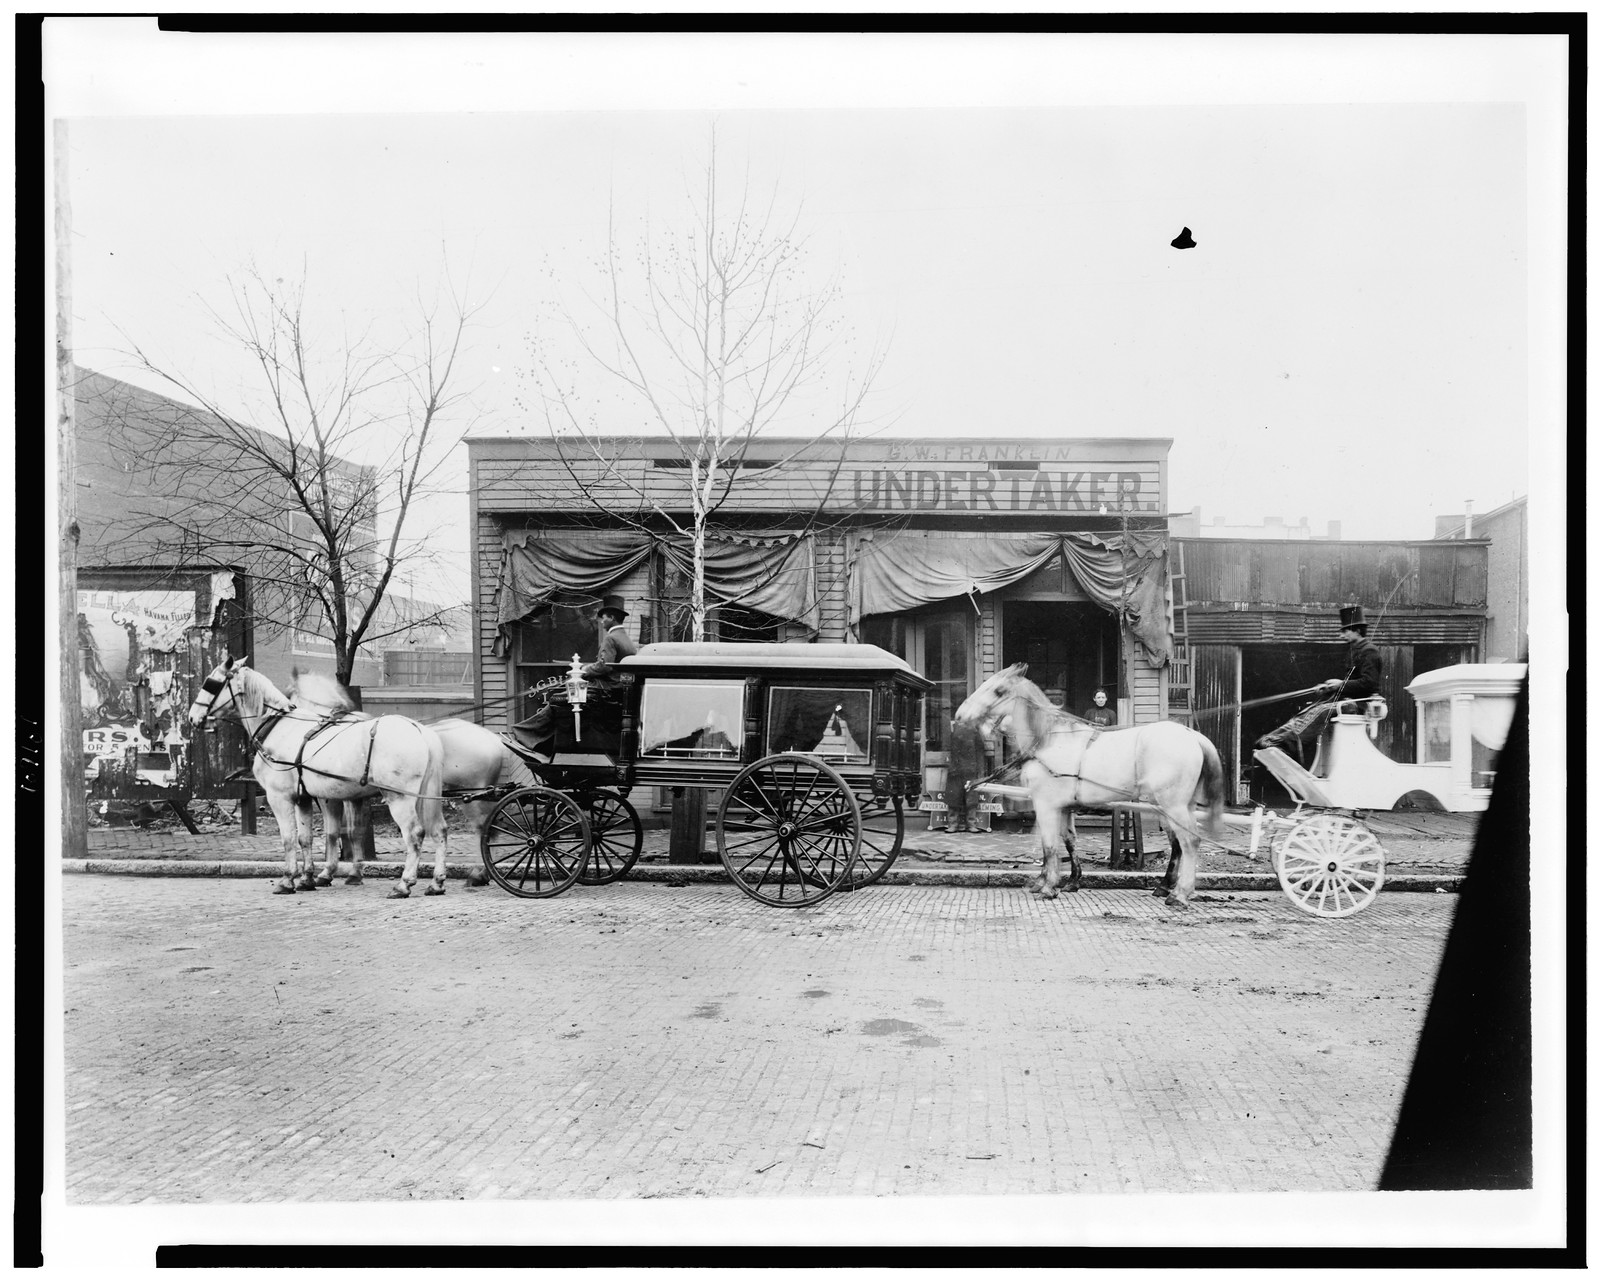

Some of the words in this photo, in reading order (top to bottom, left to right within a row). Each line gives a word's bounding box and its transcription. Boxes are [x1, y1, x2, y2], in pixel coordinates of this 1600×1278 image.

[915, 447, 938, 460] W.
[944, 446, 1071, 460] FRANKLIN
[853, 470, 1157, 511] UNDERTAKER.
